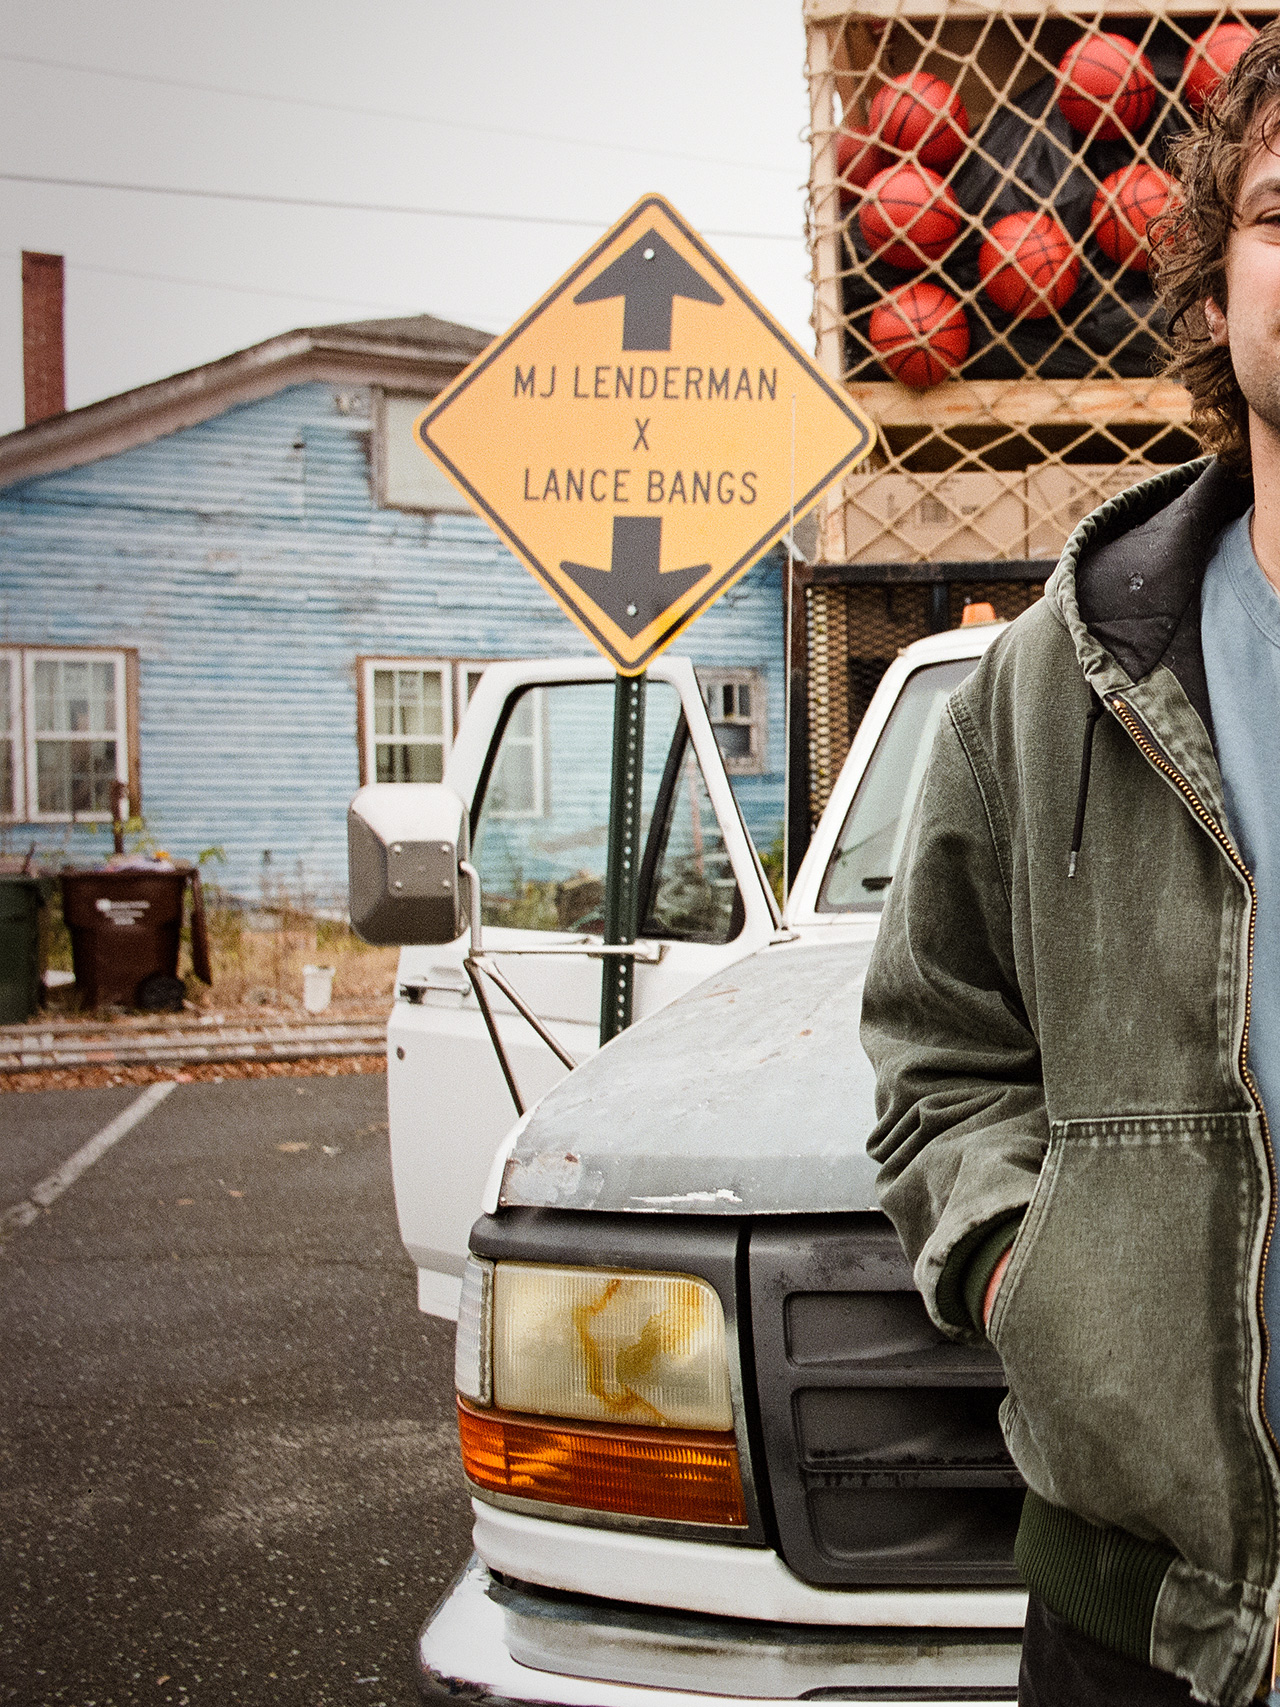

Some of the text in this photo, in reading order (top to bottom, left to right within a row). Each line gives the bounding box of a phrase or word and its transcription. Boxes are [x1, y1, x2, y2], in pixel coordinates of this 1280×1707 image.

[513, 365, 777, 400] MJ LENDERMAN
[633, 418, 649, 451] X
[524, 468, 758, 505] LANCE BANGS
